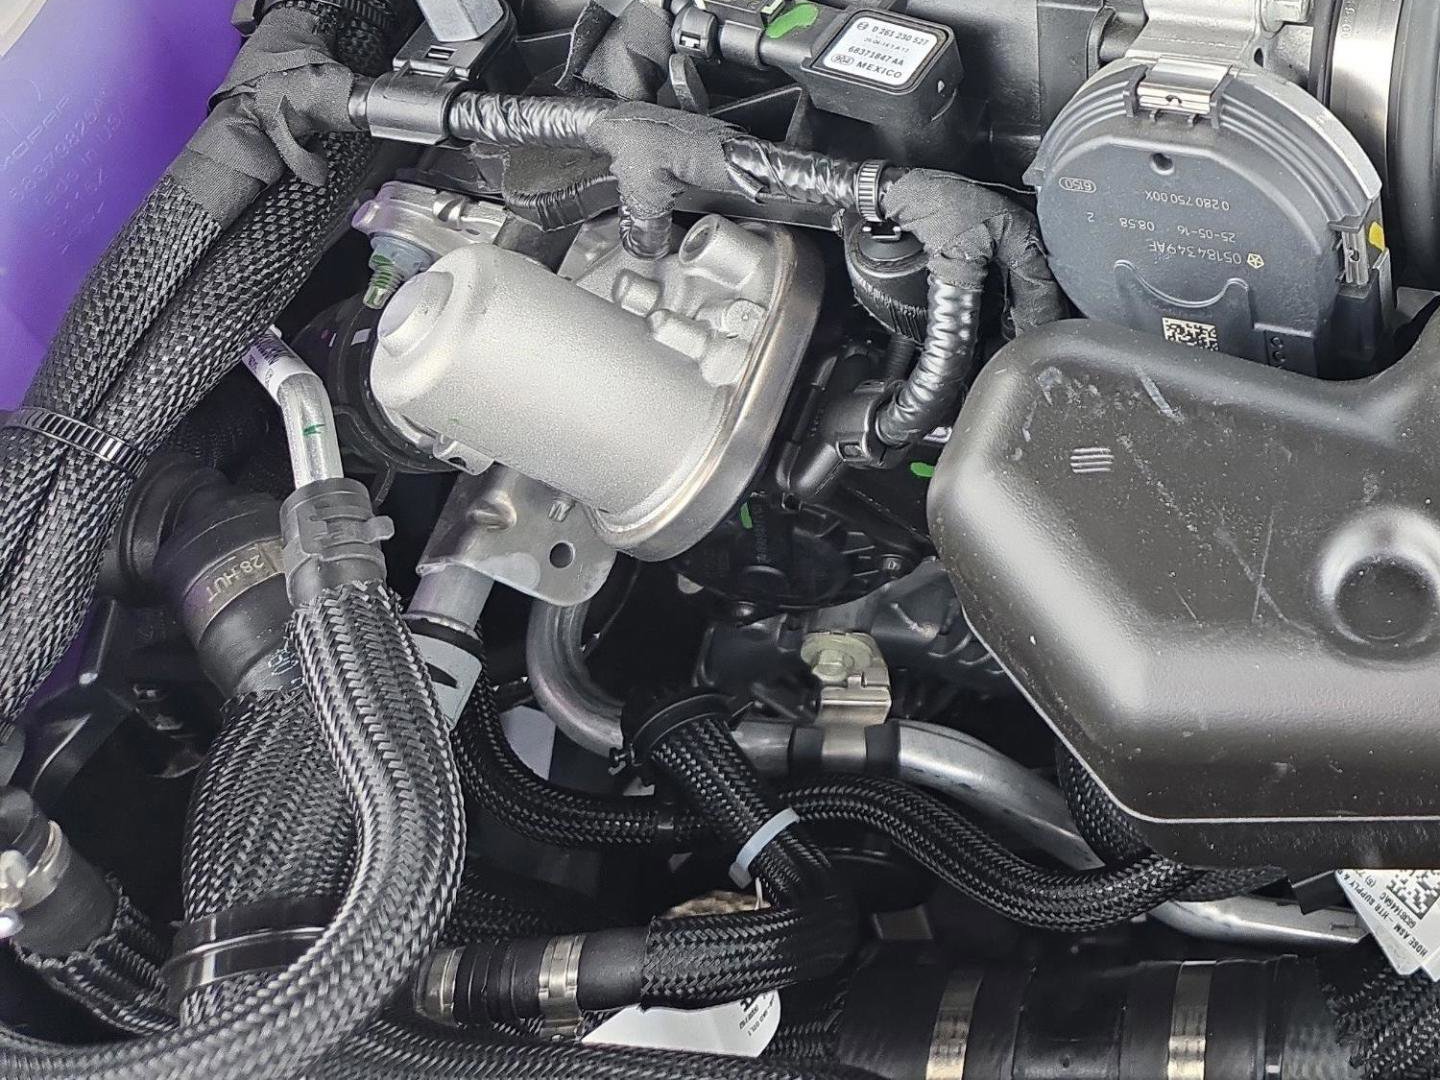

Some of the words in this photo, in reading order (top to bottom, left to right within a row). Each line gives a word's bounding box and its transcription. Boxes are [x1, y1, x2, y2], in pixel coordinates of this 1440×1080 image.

[855, 60, 902, 79] MEXICO
[1347, 878, 1376, 906] SUPPLY
[1392, 922, 1410, 939] ASM
